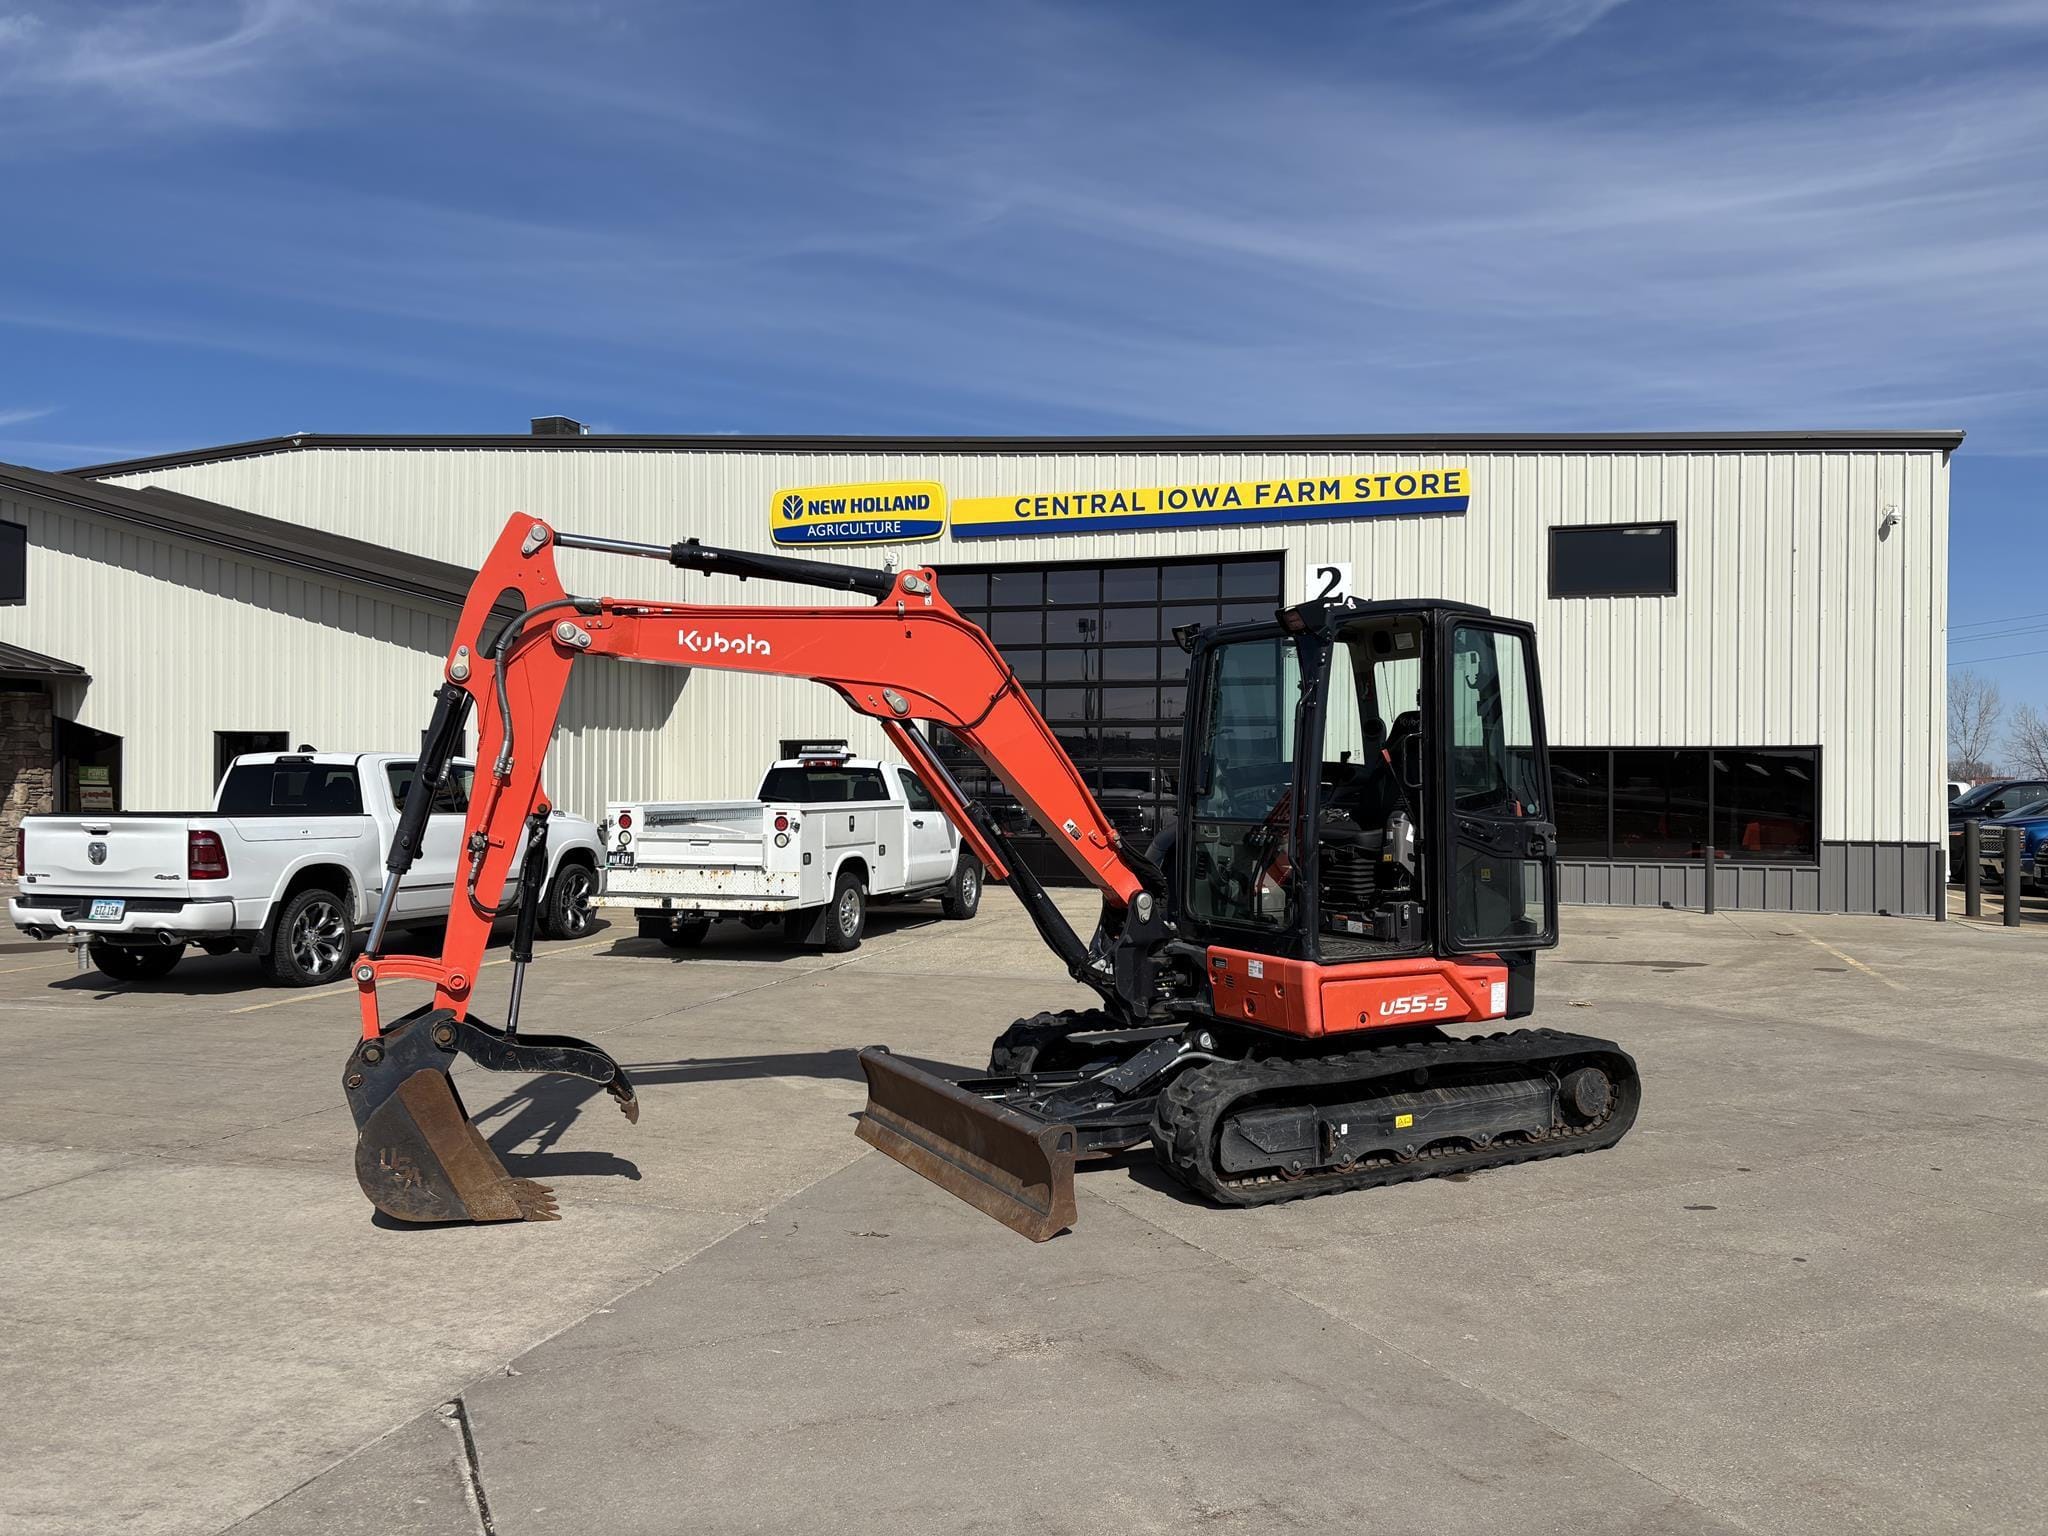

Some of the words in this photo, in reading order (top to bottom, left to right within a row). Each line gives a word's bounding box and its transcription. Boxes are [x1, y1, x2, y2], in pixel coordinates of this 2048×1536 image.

[808, 498, 847, 516] NEW
[850, 494, 930, 513] HOLLAND
[1014, 492, 1146, 518] CENTRAL
[1158, 486, 1242, 510] IOWA
[1255, 479, 1341, 504] FARM
[1354, 472, 1461, 499] STORE
[807, 521, 902, 537] AGRICULTURE
[1316, 566, 1344, 604] 2
[678, 629, 771, 656] Kubota
